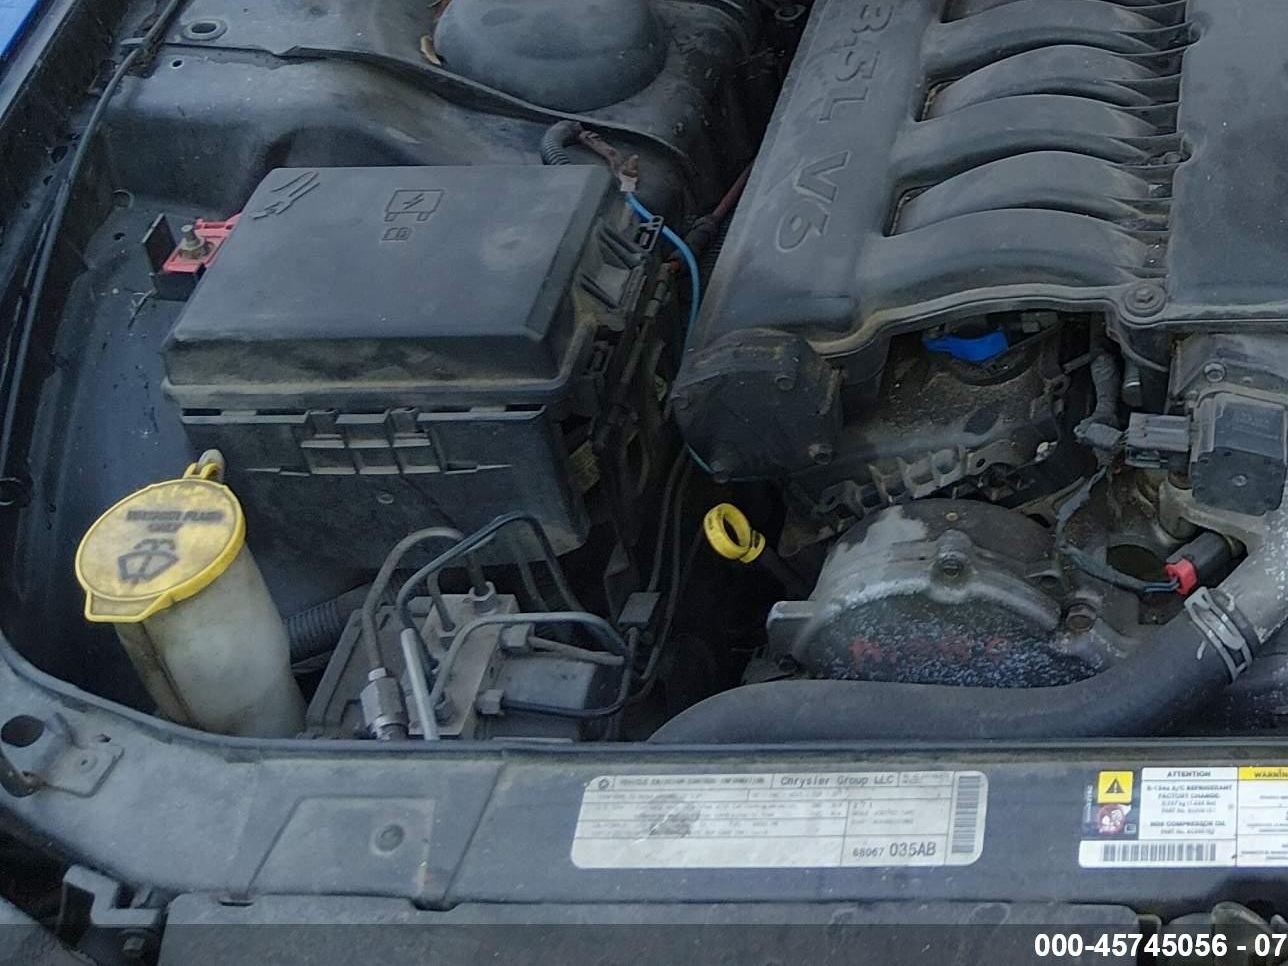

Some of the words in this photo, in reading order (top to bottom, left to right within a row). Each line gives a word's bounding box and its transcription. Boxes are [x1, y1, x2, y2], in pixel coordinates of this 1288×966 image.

[775, 150, 850, 253] V6
[1166, 770, 1211, 778] ATTENTION
[780, 776, 831, 787] Chrysler
[837, 777, 870, 787] Group
[874, 776, 894, 785] LLC
[888, 842, 937, 857] 035AB
